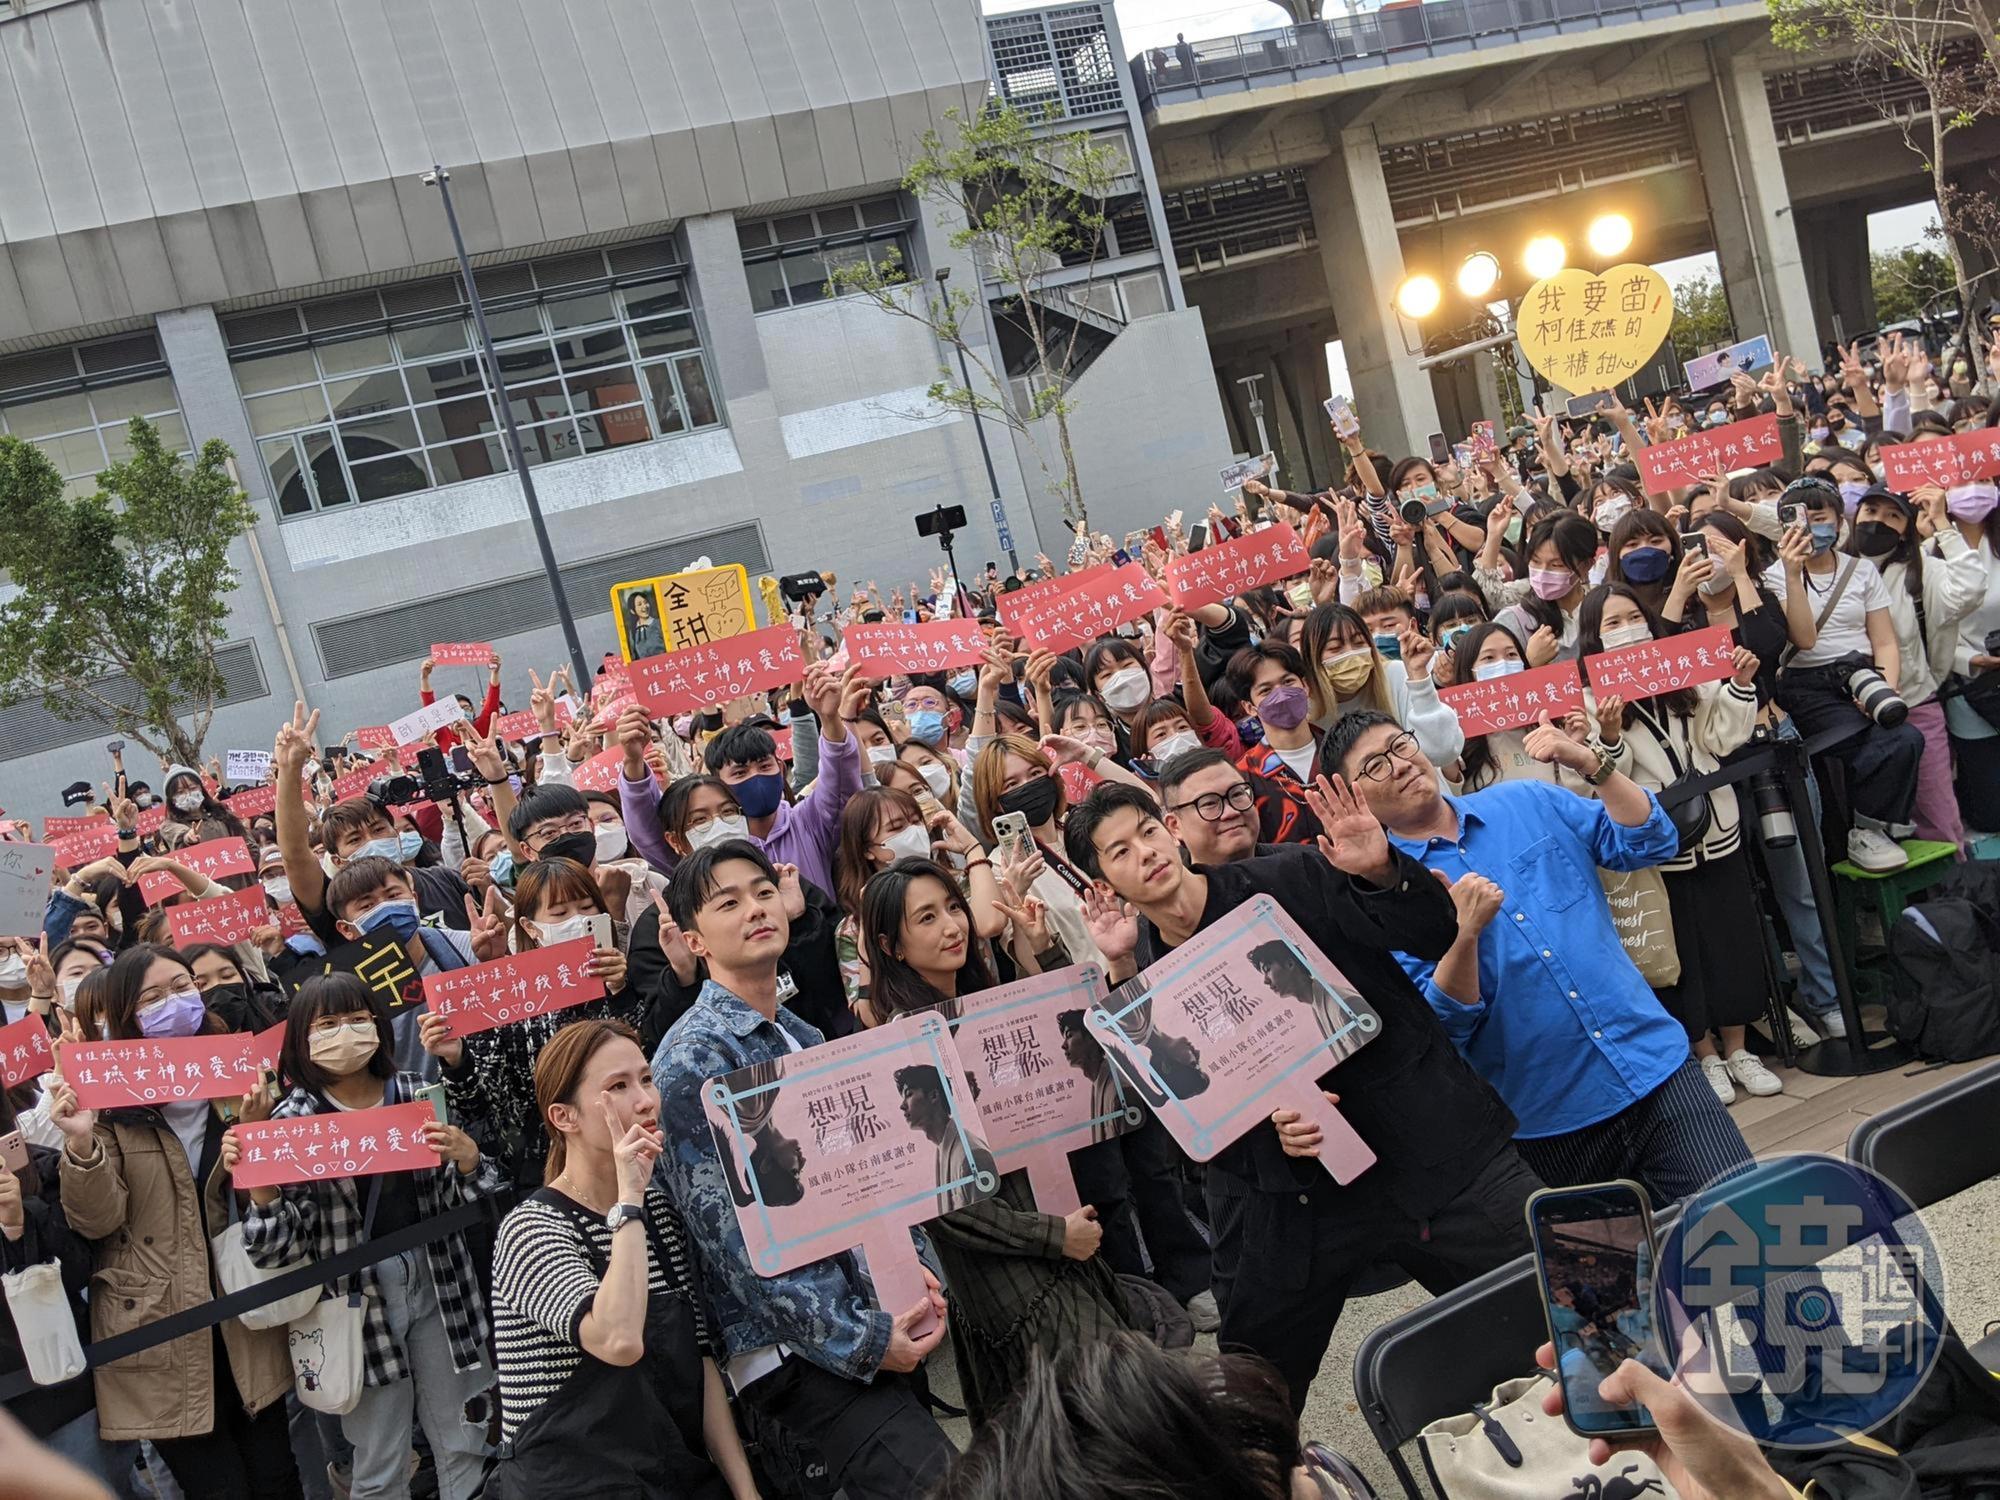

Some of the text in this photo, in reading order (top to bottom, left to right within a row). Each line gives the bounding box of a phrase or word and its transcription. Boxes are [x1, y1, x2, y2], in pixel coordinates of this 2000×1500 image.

[1534, 317, 1643, 347] 柯佳嬿的
[647, 646, 800, 699] 佳嬿女神我愛你
[1056, 863, 1082, 888] Canon
[78, 1055, 256, 1085] 佳嬿女神我愛你
[807, 1141, 917, 1189] 鳳南小隊台南感謝會
